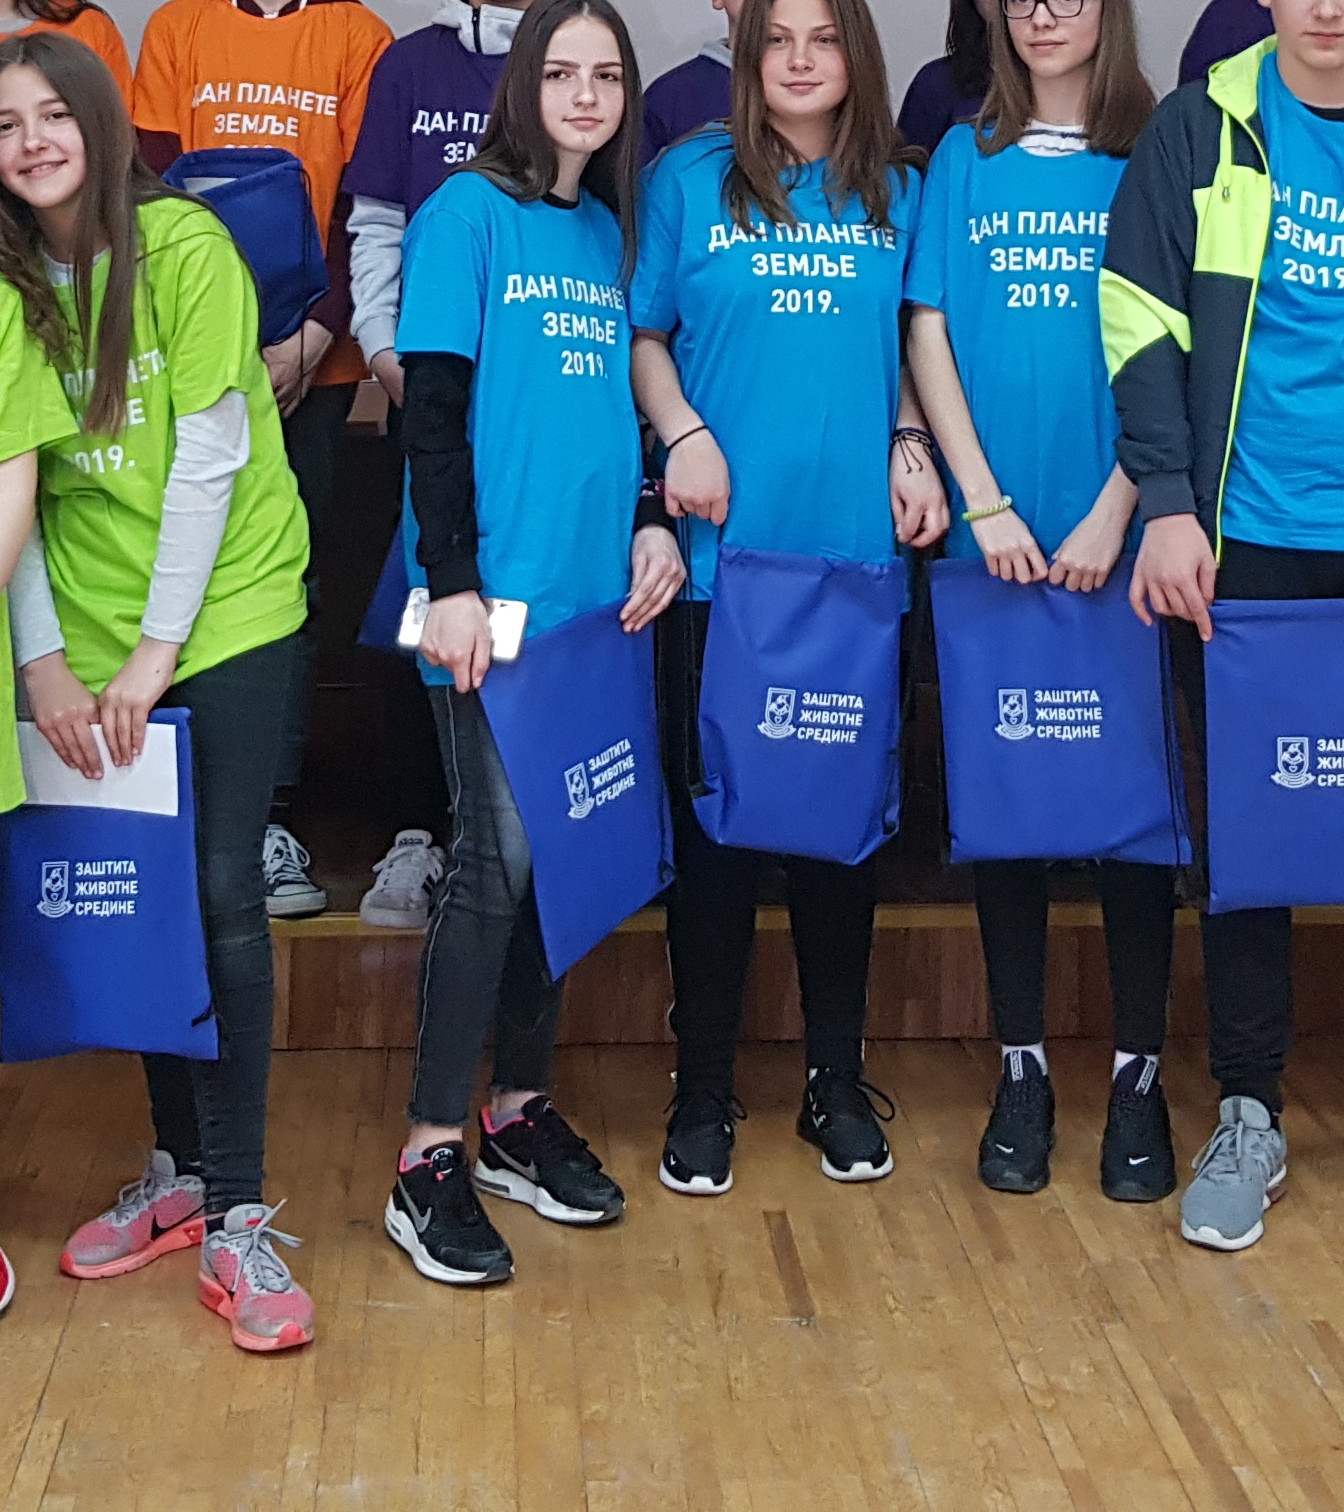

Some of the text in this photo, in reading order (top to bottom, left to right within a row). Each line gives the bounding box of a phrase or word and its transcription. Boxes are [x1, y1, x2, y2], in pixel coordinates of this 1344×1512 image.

[237, 83, 339, 116] ПЛАНЕТЕ
[214, 113, 299, 137] ЗЕМЉЕ
[1017, 211, 1110, 236] ПЛАНЕ
[708, 222, 897, 253] ДАН ПЛАНЕТЕ
[751, 253, 857, 278] ЗЕМЉЕ
[990, 247, 1095, 272] ЗЕМЉЕ
[504, 274, 625, 310] ДАН ПЛАНЕ
[770, 289, 840, 314] 2019.
[1007, 283, 1078, 308] 2019.
[543, 311, 616, 344] ЗЕМЉЕ
[561, 350, 608, 379] 2019.
[802, 692, 863, 709] ЗАШТИТА
[1034, 690, 1100, 703] ЗАШТИТА
[799, 709, 863, 726] ЖИВОТНЕ
[1035, 707, 1103, 721] ЖИВОТНЕ
[797, 727, 858, 744] СРЕДИНЕ
[1036, 725, 1101, 741] СРЕДИНЕ
[588, 738, 631, 771] ЗАШТИТА
[592, 754, 635, 790] ЖИВОТНЕ
[596, 773, 636, 806] СРЕДИНЕ
[75, 861, 137, 876] ЗАШТИТА
[75, 880, 138, 896] ЖИВОТНЕ
[75, 900, 136, 917] СРЕДИНЕ
